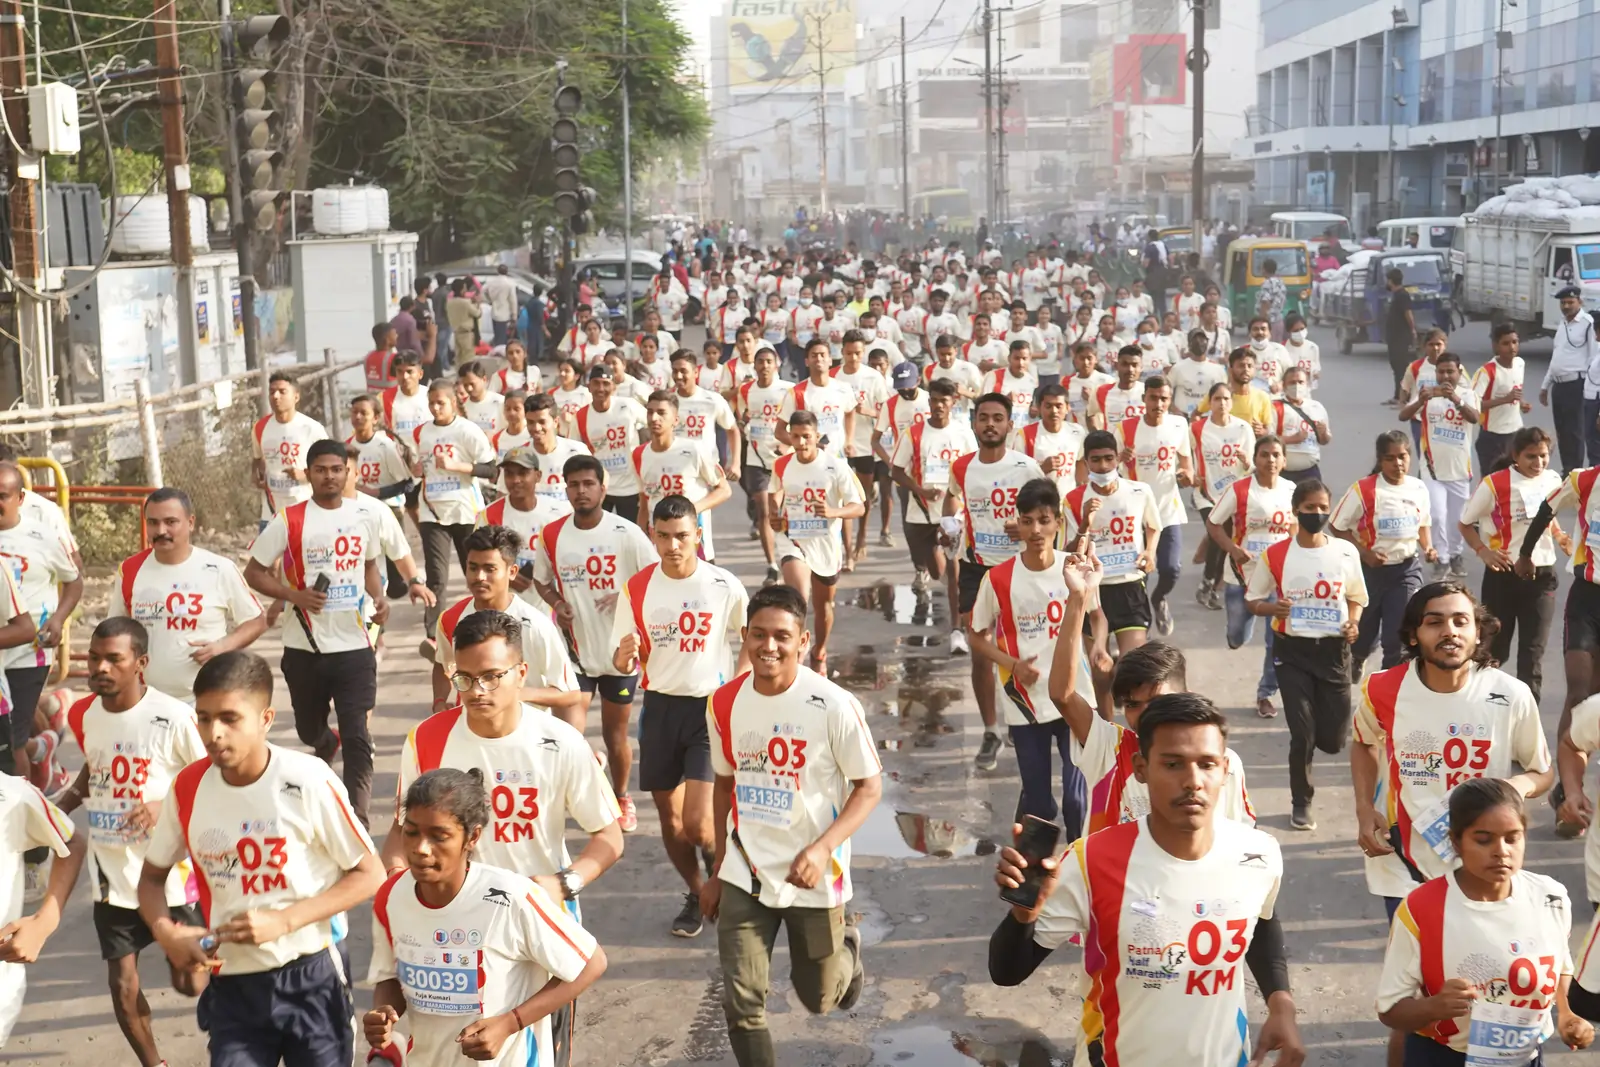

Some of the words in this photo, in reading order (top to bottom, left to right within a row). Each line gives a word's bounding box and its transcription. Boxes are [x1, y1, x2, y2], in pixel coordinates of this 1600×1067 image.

[1262, 361, 1277, 371] 03
[649, 376, 662, 387] 03
[1126, 406, 1147, 418] 03
[687, 416, 706, 428] 03
[607, 427, 626, 441] 03
[280, 442, 300, 456] 03
[609, 441, 626, 450] KM
[1058, 453, 1075, 466] 03
[1158, 447, 1176, 461] 03
[361, 463, 381, 477] 03
[1158, 462, 1172, 472] KM
[661, 475, 684, 491] 03
[803, 488, 826, 502] 03
[991, 488, 1018, 506] 03
[993, 508, 1015, 518] KM
[1110, 516, 1135, 535] 03
[334, 536, 362, 556] 03
[1112, 535, 1133, 545] KM
[336, 559, 358, 571] KM
[586, 555, 616, 576] 03
[589, 577, 614, 590] KM
[1315, 580, 1343, 600] 03
[166, 592, 204, 615] 03
[1046, 599, 1068, 624] 0
[1300, 609, 1337, 621] 30456
[167, 617, 197, 630] KM
[679, 612, 712, 635] 03
[680, 639, 705, 652] KM
[768, 737, 807, 770] 03
[1401, 751, 1424, 760] Patna
[1443, 738, 1492, 769] 03
[112, 755, 152, 787] 03
[1400, 769, 1440, 778] Marathon
[491, 786, 539, 820] 03
[749, 788, 788, 808] 31356
[494, 822, 534, 843] KM
[236, 837, 288, 871] 03
[241, 872, 288, 897] KM
[1188, 918, 1247, 966] 03
[1128, 944, 1161, 955] Patna
[1129, 956, 1150, 967] Half
[406, 967, 468, 991] 30039
[1126, 968, 1180, 979] Marathon
[1508, 955, 1557, 996] 03
[1185, 966, 1236, 996] KM
[427, 1002, 458, 1010] MARATHON
